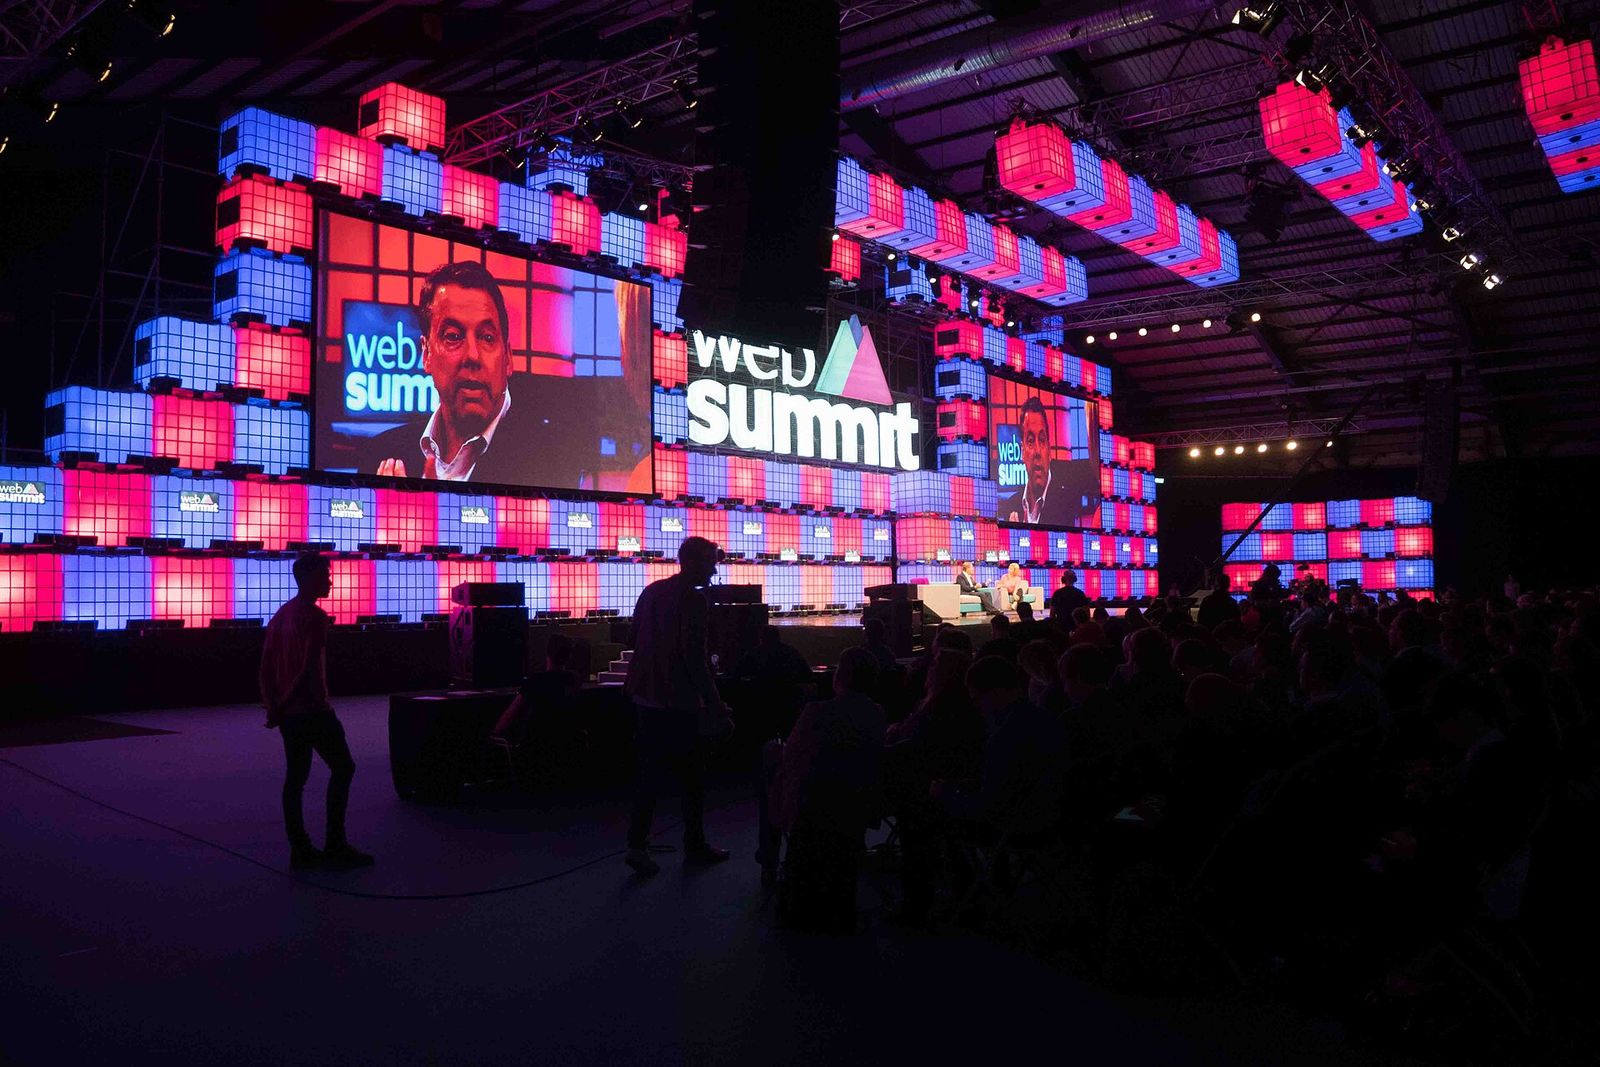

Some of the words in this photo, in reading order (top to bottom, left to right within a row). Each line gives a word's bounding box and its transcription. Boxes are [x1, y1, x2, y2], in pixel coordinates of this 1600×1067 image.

[346, 320, 417, 370] web
[345, 371, 439, 412] summ
[686, 378, 920, 471] summit
[998, 433, 1020, 462] web
[998, 463, 1029, 486] summ
[0, 483, 23, 494] web
[0, 492, 46, 504] summit
[181, 494, 201, 504] web
[331, 501, 348, 511] web
[180, 502, 219, 513] summit
